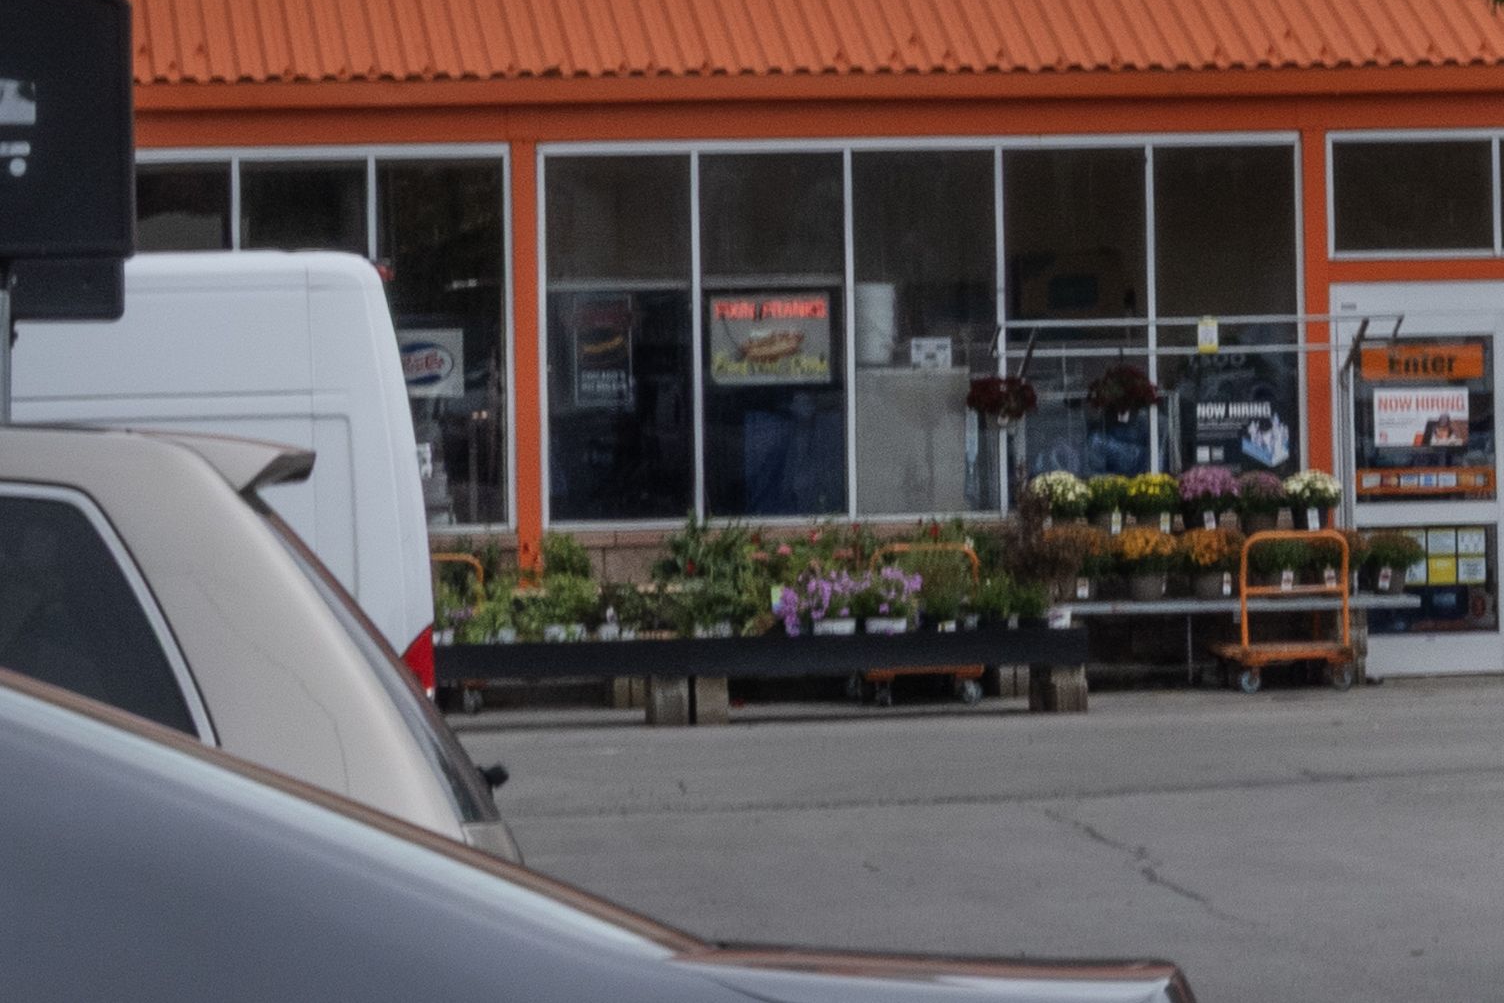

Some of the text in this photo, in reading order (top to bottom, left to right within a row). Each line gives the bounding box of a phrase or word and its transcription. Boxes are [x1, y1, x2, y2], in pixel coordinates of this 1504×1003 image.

[1196, 401, 1271, 419] NOW HIRING
[1378, 394, 1465, 413] NOW HIRING
